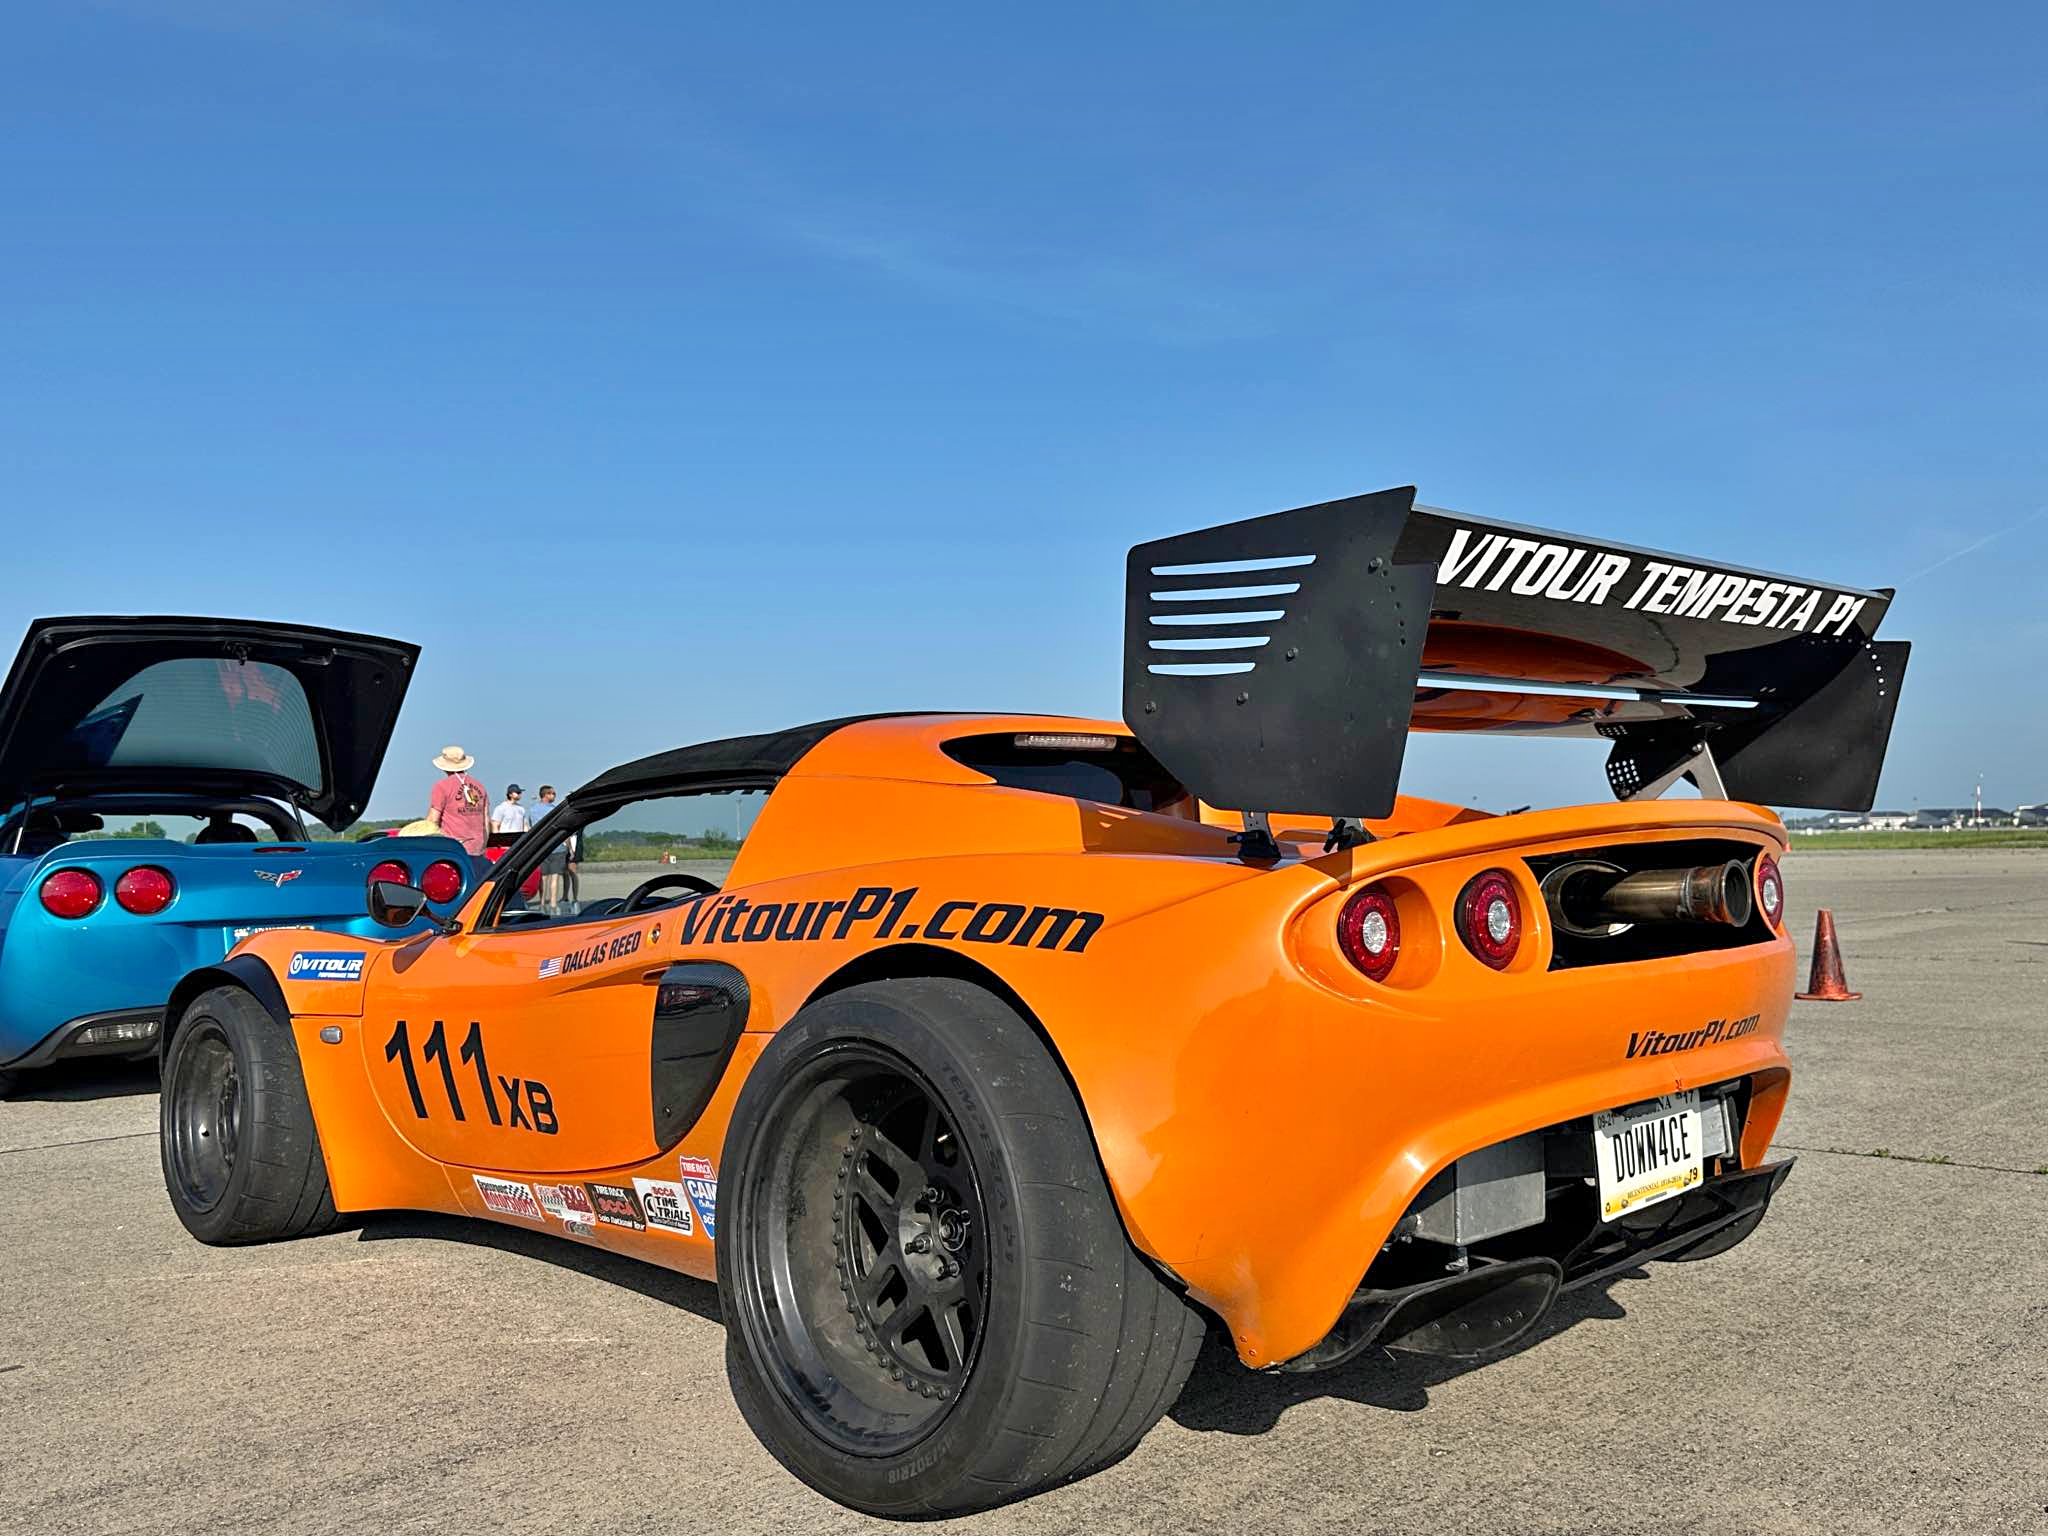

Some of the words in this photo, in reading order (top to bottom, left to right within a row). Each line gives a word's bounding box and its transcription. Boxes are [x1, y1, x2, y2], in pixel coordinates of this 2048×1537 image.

[1436, 528, 1630, 606] VITOUR
[1624, 561, 1823, 633] TEMPESTA
[1813, 595, 1868, 637] P1
[680, 886, 1105, 953] VitourP1.com
[302, 959, 363, 971] VITOUR
[562, 941, 608, 974] DALLAS
[608, 931, 642, 961] REED
[1625, 1013, 1760, 1059] VitourP1.com
[385, 1020, 503, 1126] 111
[497, 1075, 559, 1135] XB
[1613, 1113, 1691, 1183] DOWN4CE
[651, 1186, 676, 1198] SCCA
[655, 1196, 678, 1208] TIME
